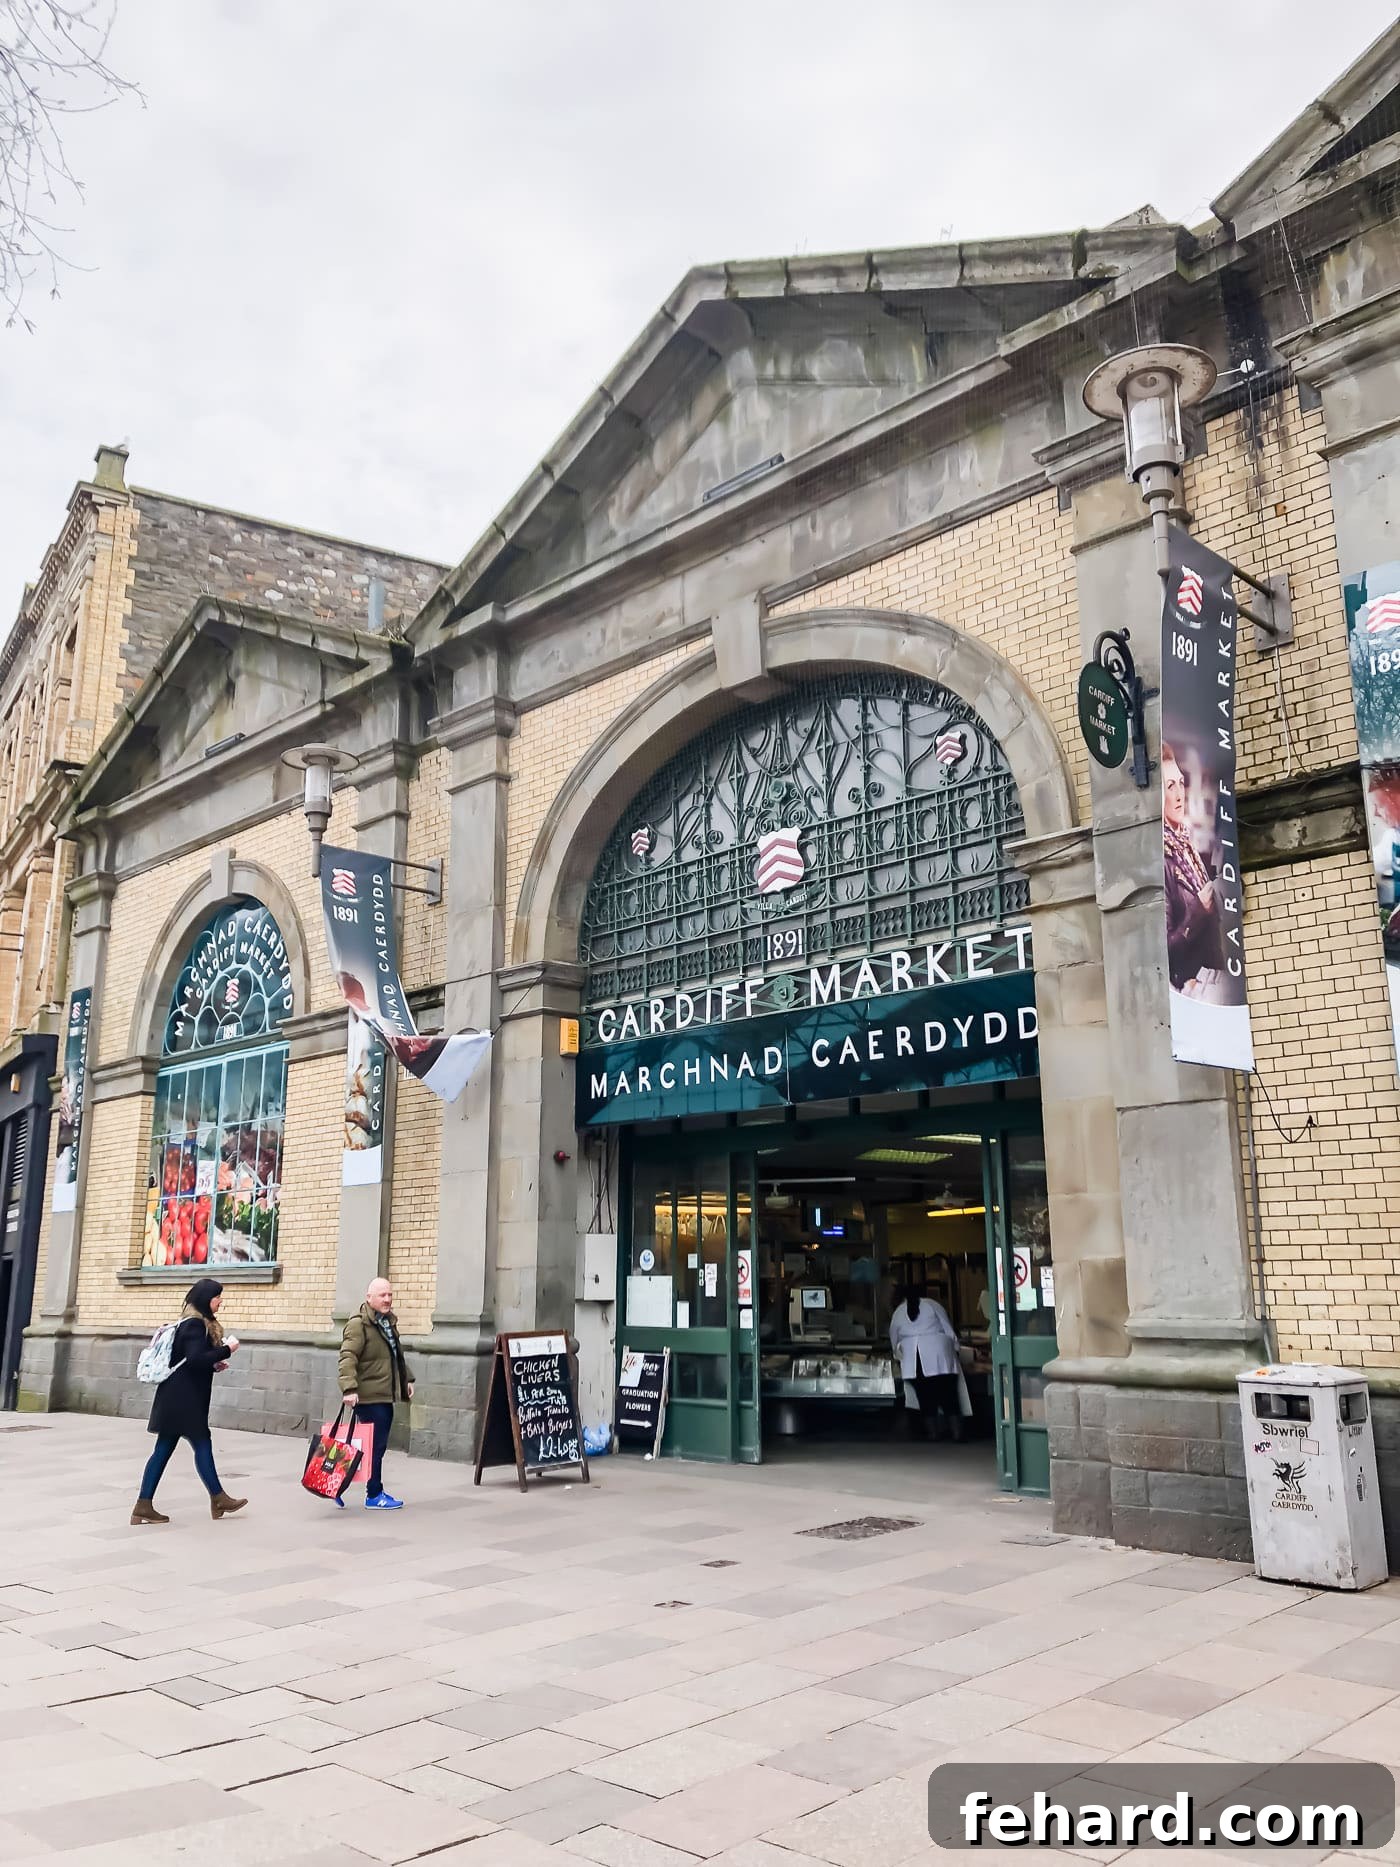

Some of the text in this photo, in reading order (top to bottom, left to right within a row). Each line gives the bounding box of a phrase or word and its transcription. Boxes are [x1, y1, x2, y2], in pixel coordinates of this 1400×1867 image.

[1172, 631, 1198, 666] 1891
[1088, 685, 1116, 707] CARDIFF
[1089, 714, 1117, 736] MARKET
[1217, 587, 1243, 977] CARDIFF MARKET
[332, 904, 359, 924] 1891
[372, 873, 390, 973] CAERDYDD
[767, 928, 803, 961] 1891
[174, 916, 293, 1037] MARCHNAD CAERDYDD
[195, 941, 275, 999] CARDIFF MARKET
[598, 926, 1033, 1043] CARDIFF MARKET
[590, 1006, 1039, 1099] MARCHNAD CAERDYDD
[70, 998, 91, 1171] MARCHNAD CAERDYDD
[513, 1355, 559, 1376] CHICKEN
[520, 1368, 560, 1385] LIVERS
[621, 1388, 659, 1399] GRADUATION
[625, 1401, 652, 1412] FLOWERS
[1262, 1424, 1309, 1439] Sbwriel
[1271, 1500, 1314, 1512] CAERDYDD
[1275, 1492, 1308, 1503] CARDIFF
